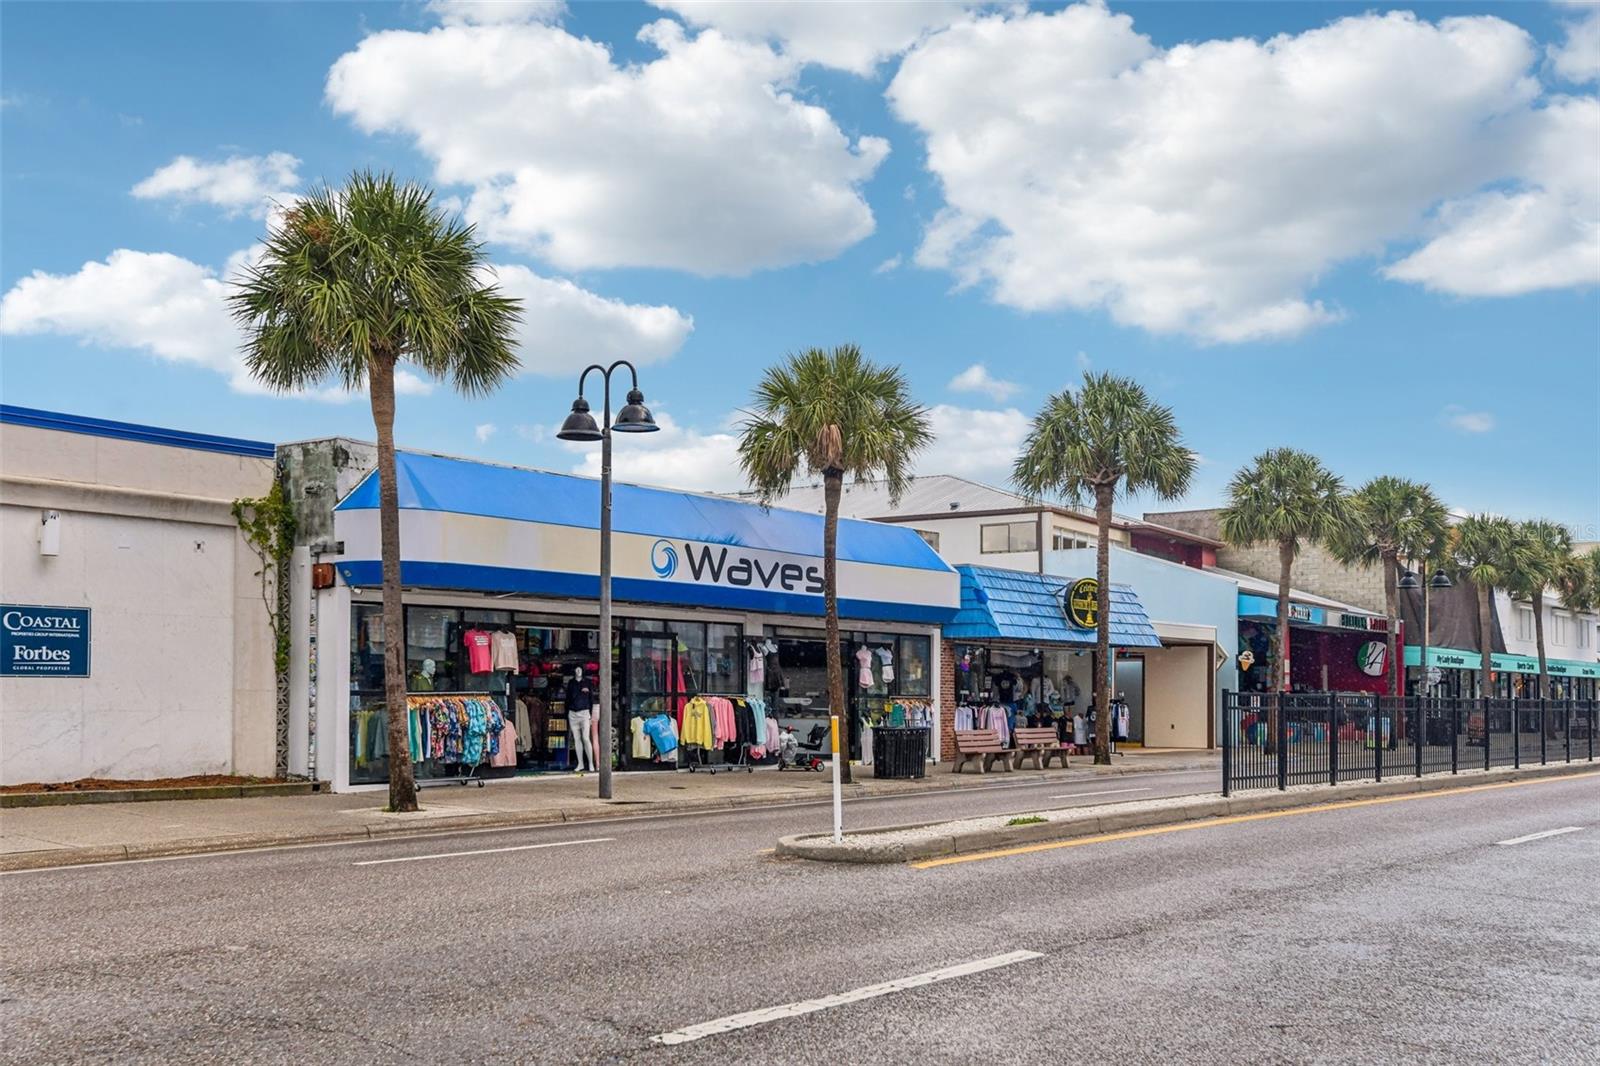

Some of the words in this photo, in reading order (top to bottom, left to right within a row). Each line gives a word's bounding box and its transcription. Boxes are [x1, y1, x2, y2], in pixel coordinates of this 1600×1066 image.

[685, 543, 825, 593] Waves
[3, 611, 81, 631] COASTAL
[13, 645, 71, 661] Forbes
[1450, 656, 1464, 666] Boutique
